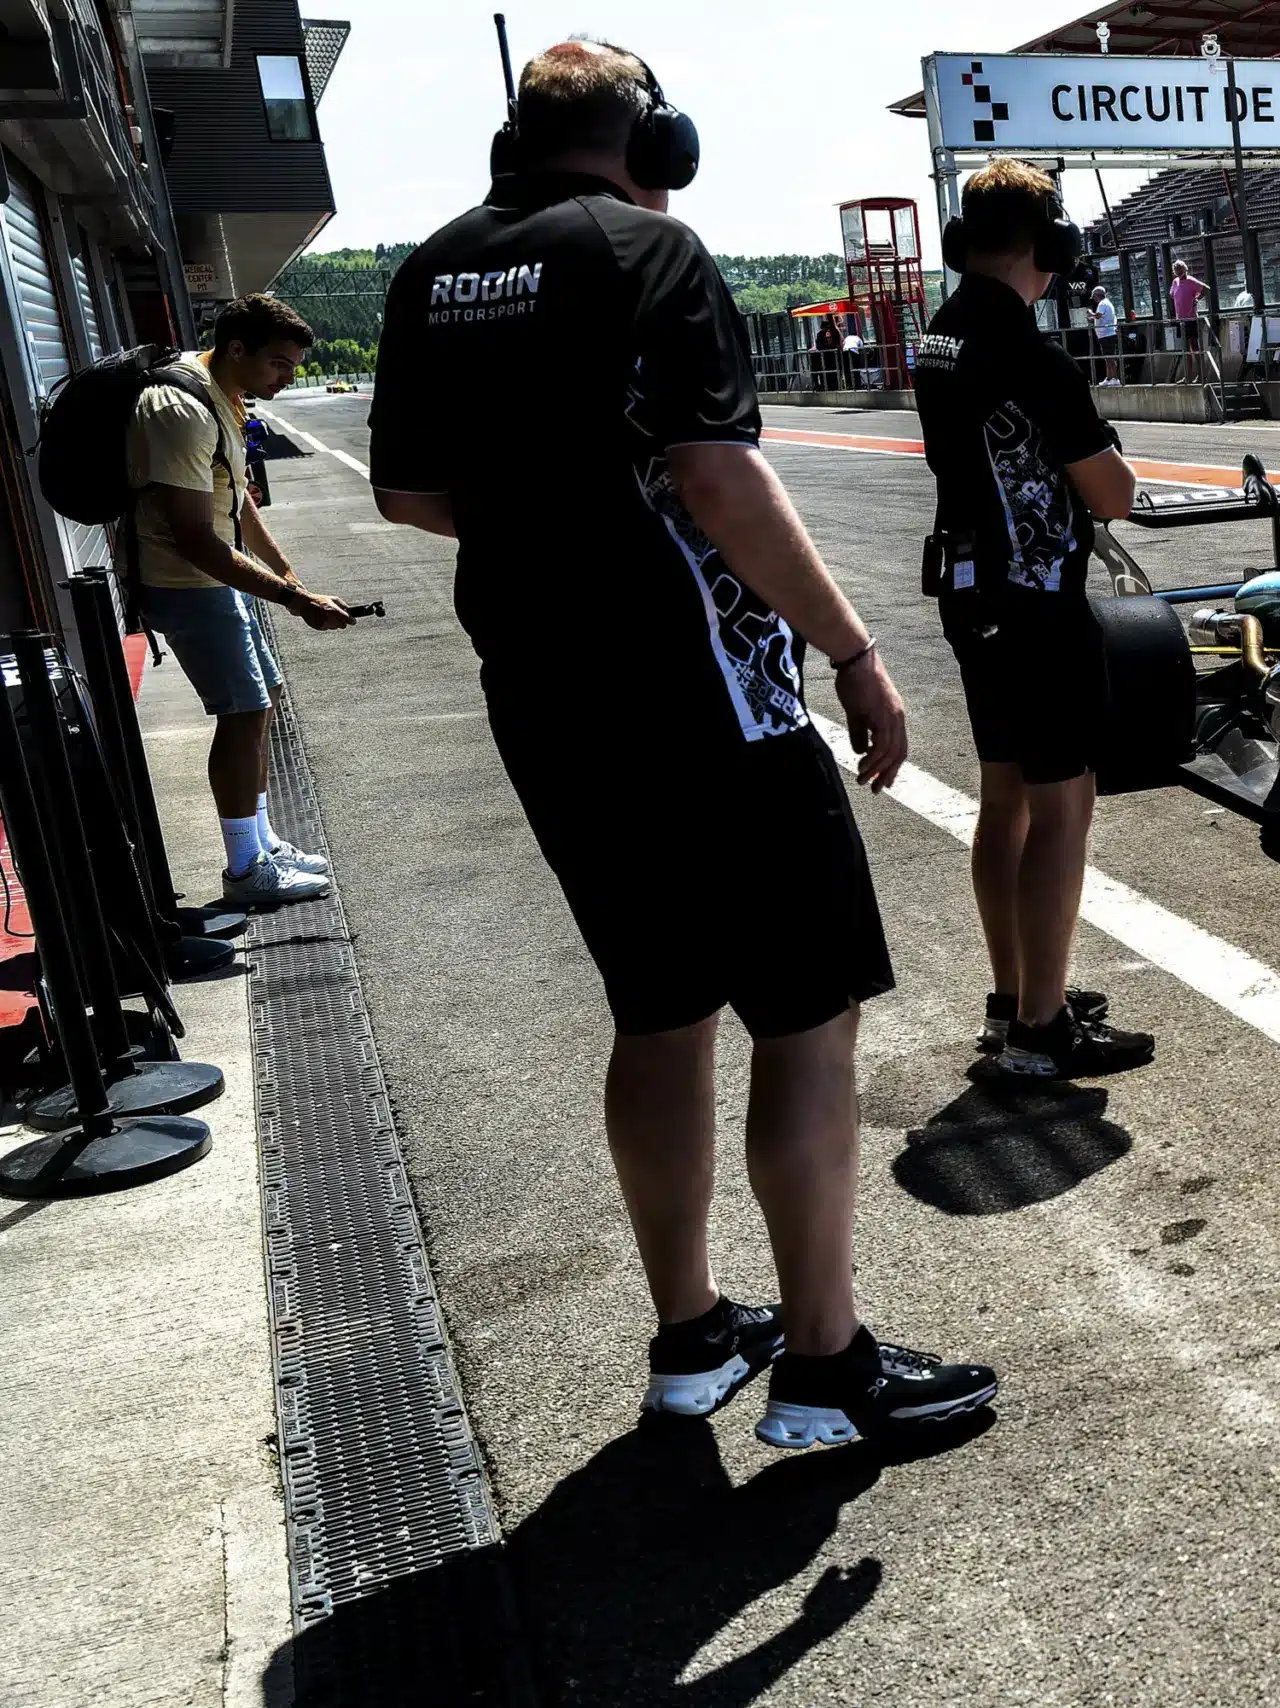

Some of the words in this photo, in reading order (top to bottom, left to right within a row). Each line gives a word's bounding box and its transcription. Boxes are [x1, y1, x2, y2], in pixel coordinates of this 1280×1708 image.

[1051, 84, 1209, 122] CIRCUIT
[1224, 86, 1275, 123] DE
[431, 262, 543, 305] RODIN
[428, 300, 536, 325] MOTORSPORT
